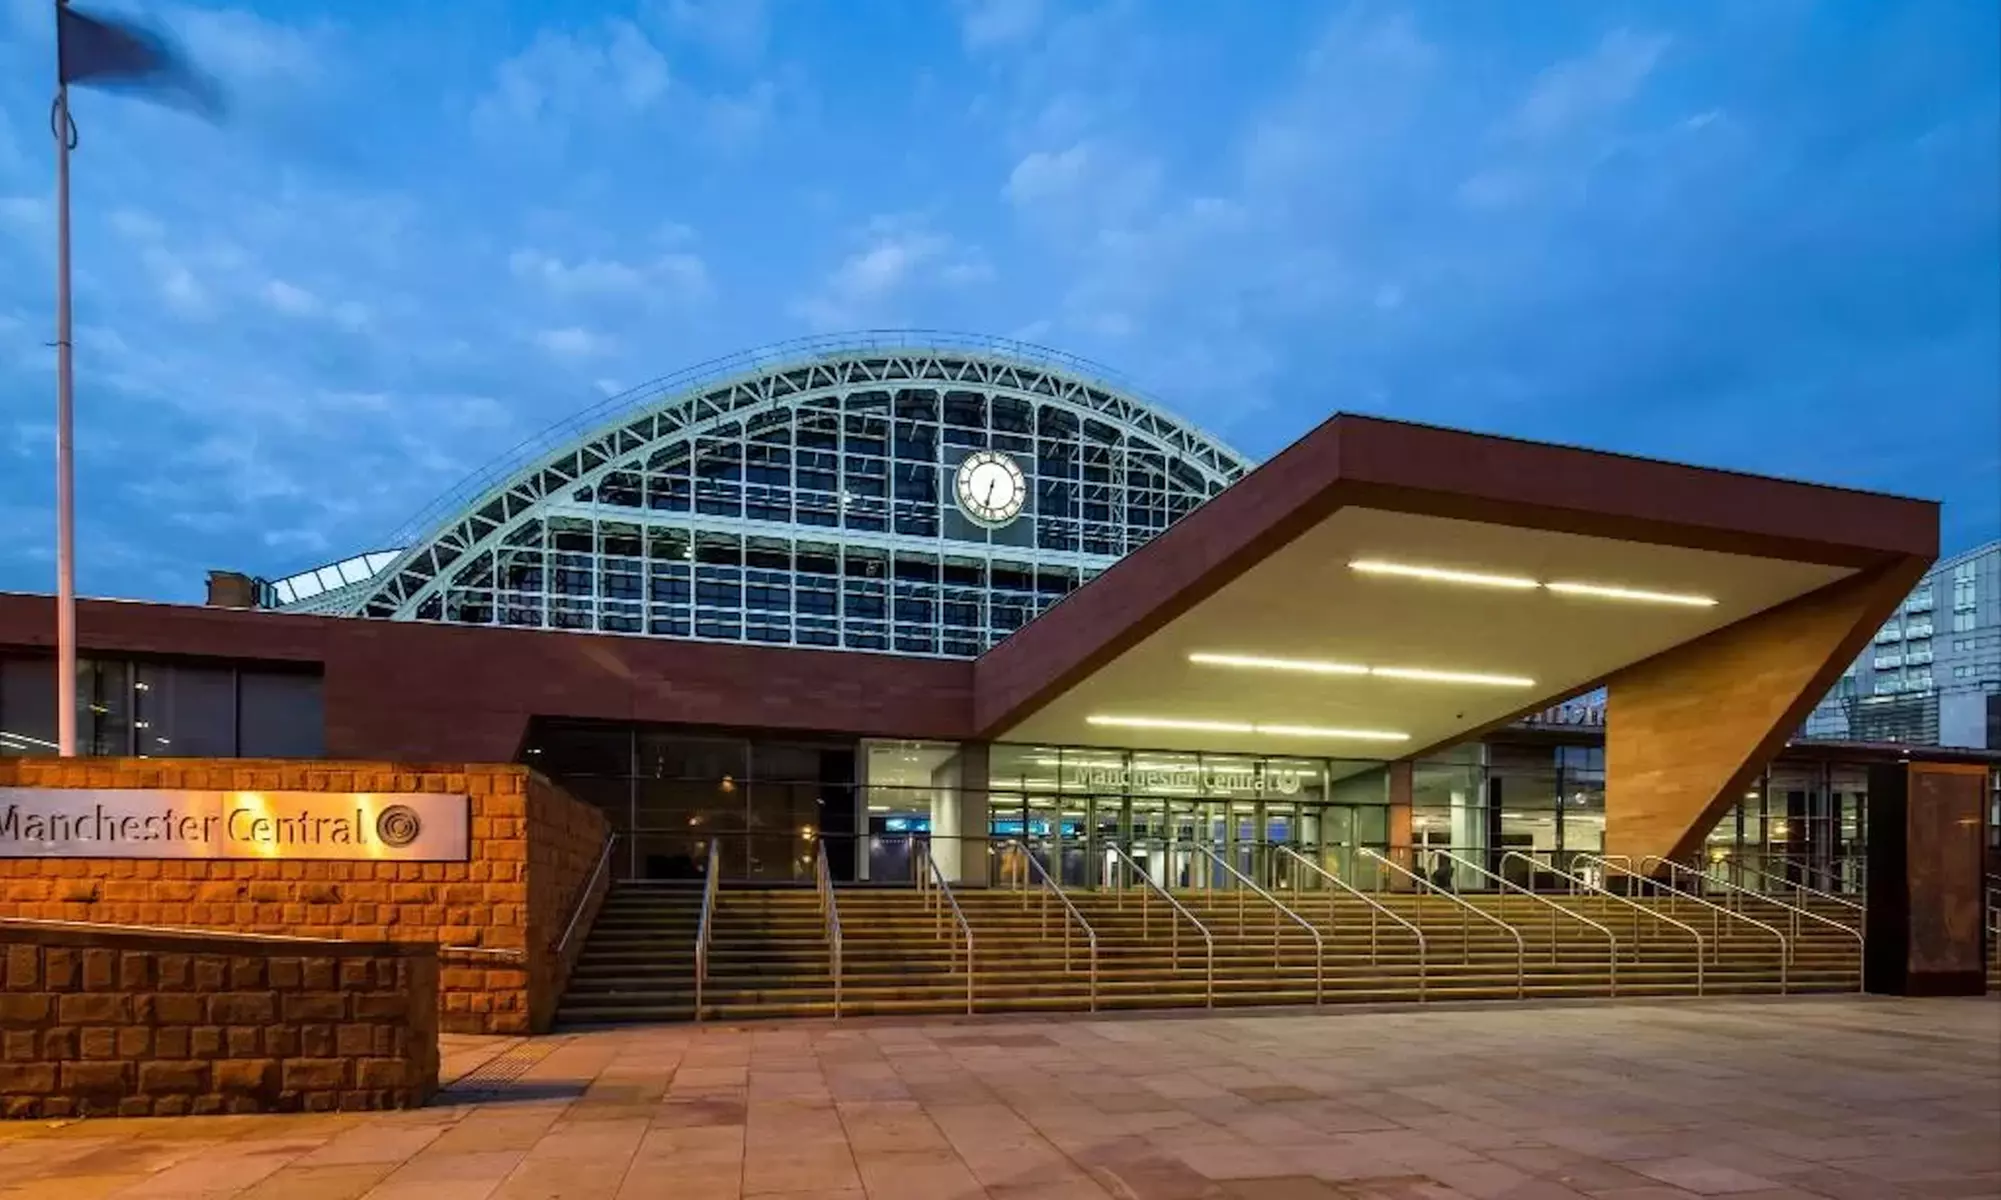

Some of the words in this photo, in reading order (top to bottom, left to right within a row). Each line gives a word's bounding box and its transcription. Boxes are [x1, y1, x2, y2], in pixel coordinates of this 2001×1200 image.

[1074, 767, 1197, 788] Manchester
[1203, 771, 1274, 793] Central
[0, 804, 219, 843] Manchester
[228, 807, 366, 845] Central
